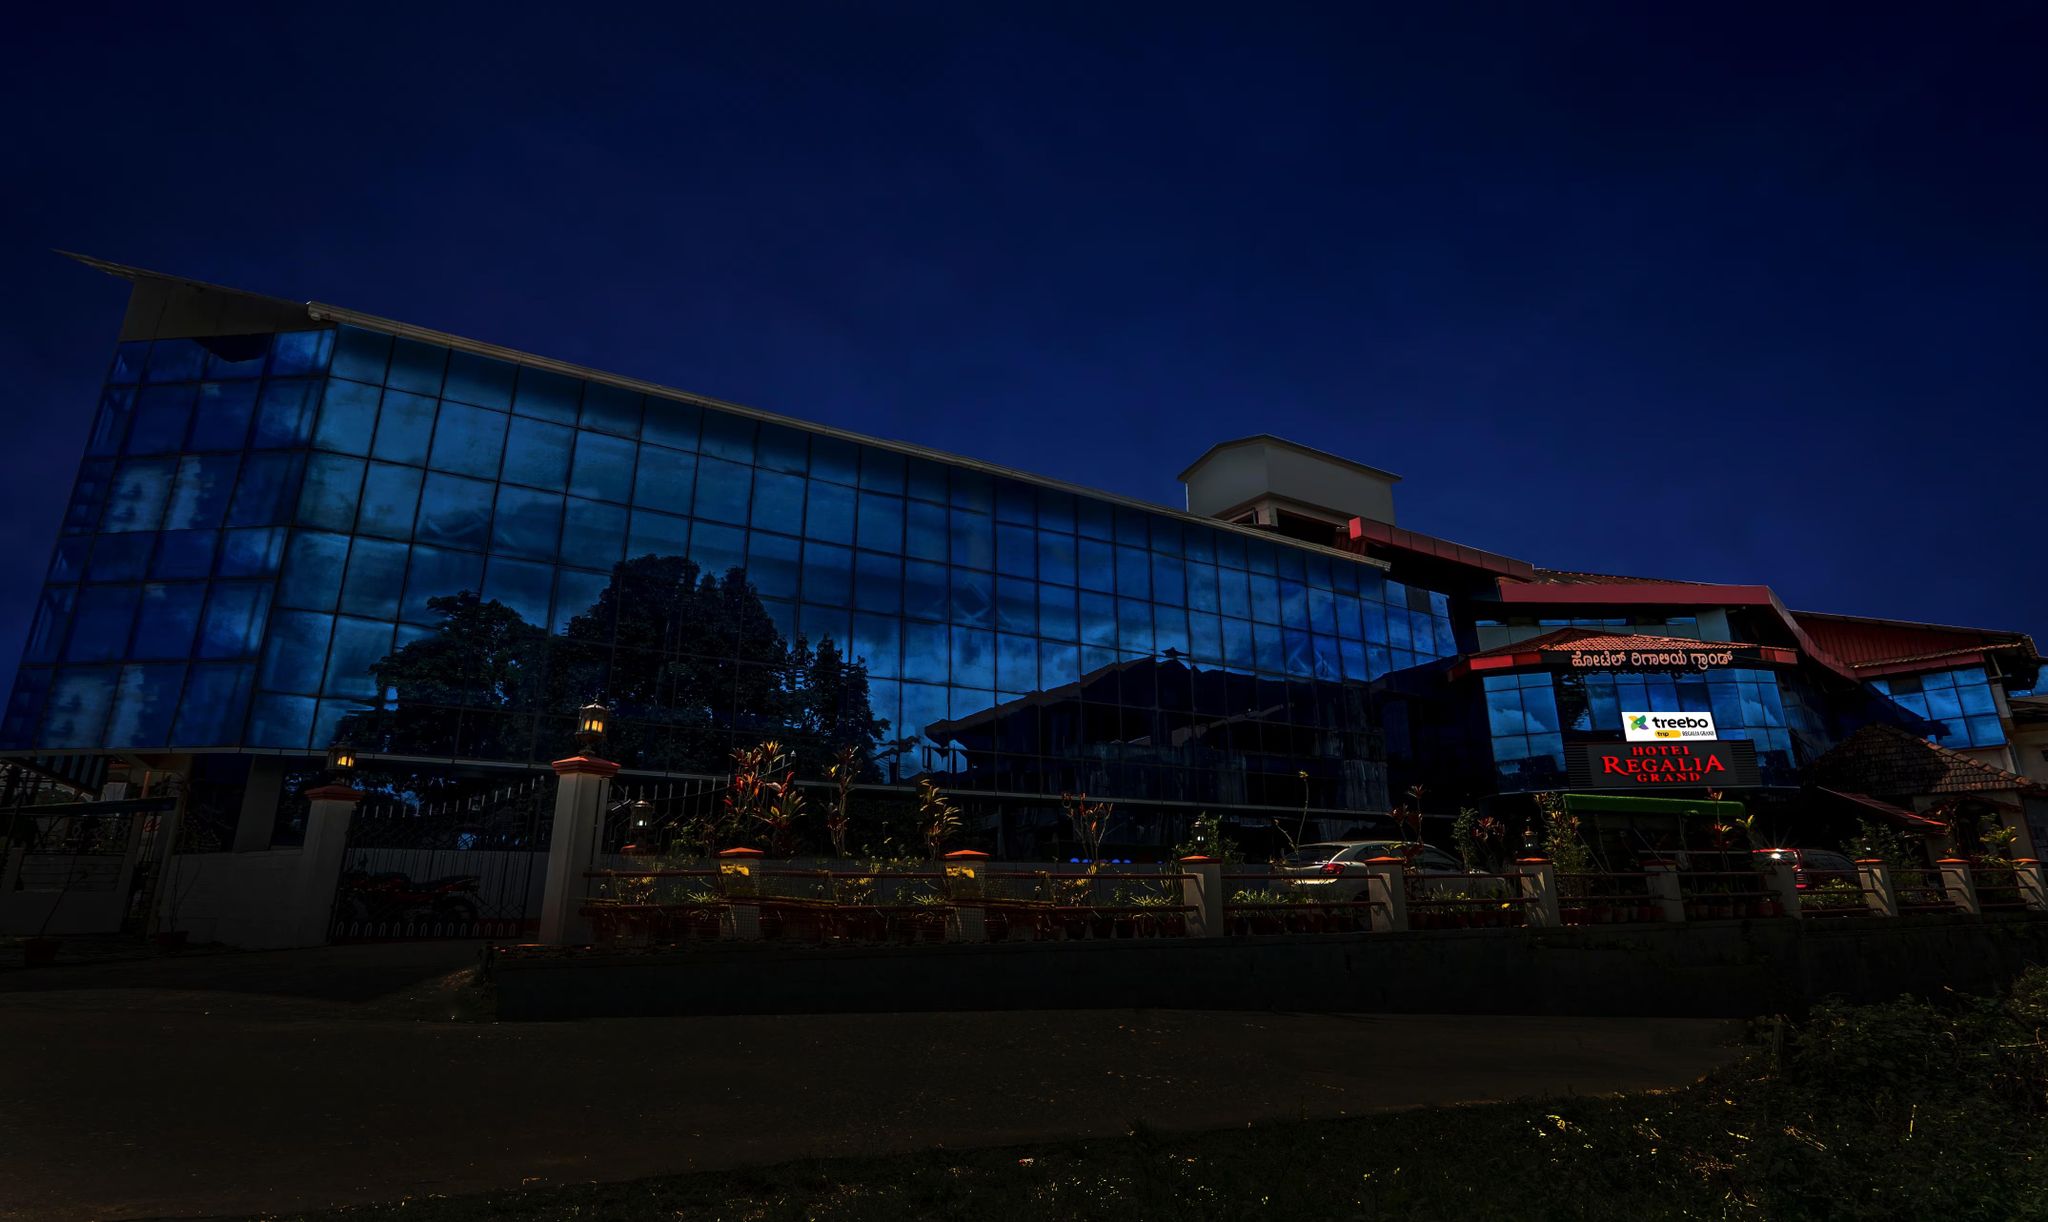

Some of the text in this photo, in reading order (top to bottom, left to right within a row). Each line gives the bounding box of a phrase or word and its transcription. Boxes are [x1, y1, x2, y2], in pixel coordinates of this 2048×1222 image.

[1571, 650, 1626, 667] ಹೋಟೆಲ್
[1652, 716, 1709, 729] treebo
[1632, 745, 1691, 756] HOTEL
[1601, 754, 1726, 776] REGALIA
[1636, 772, 1701, 783] GRAND
